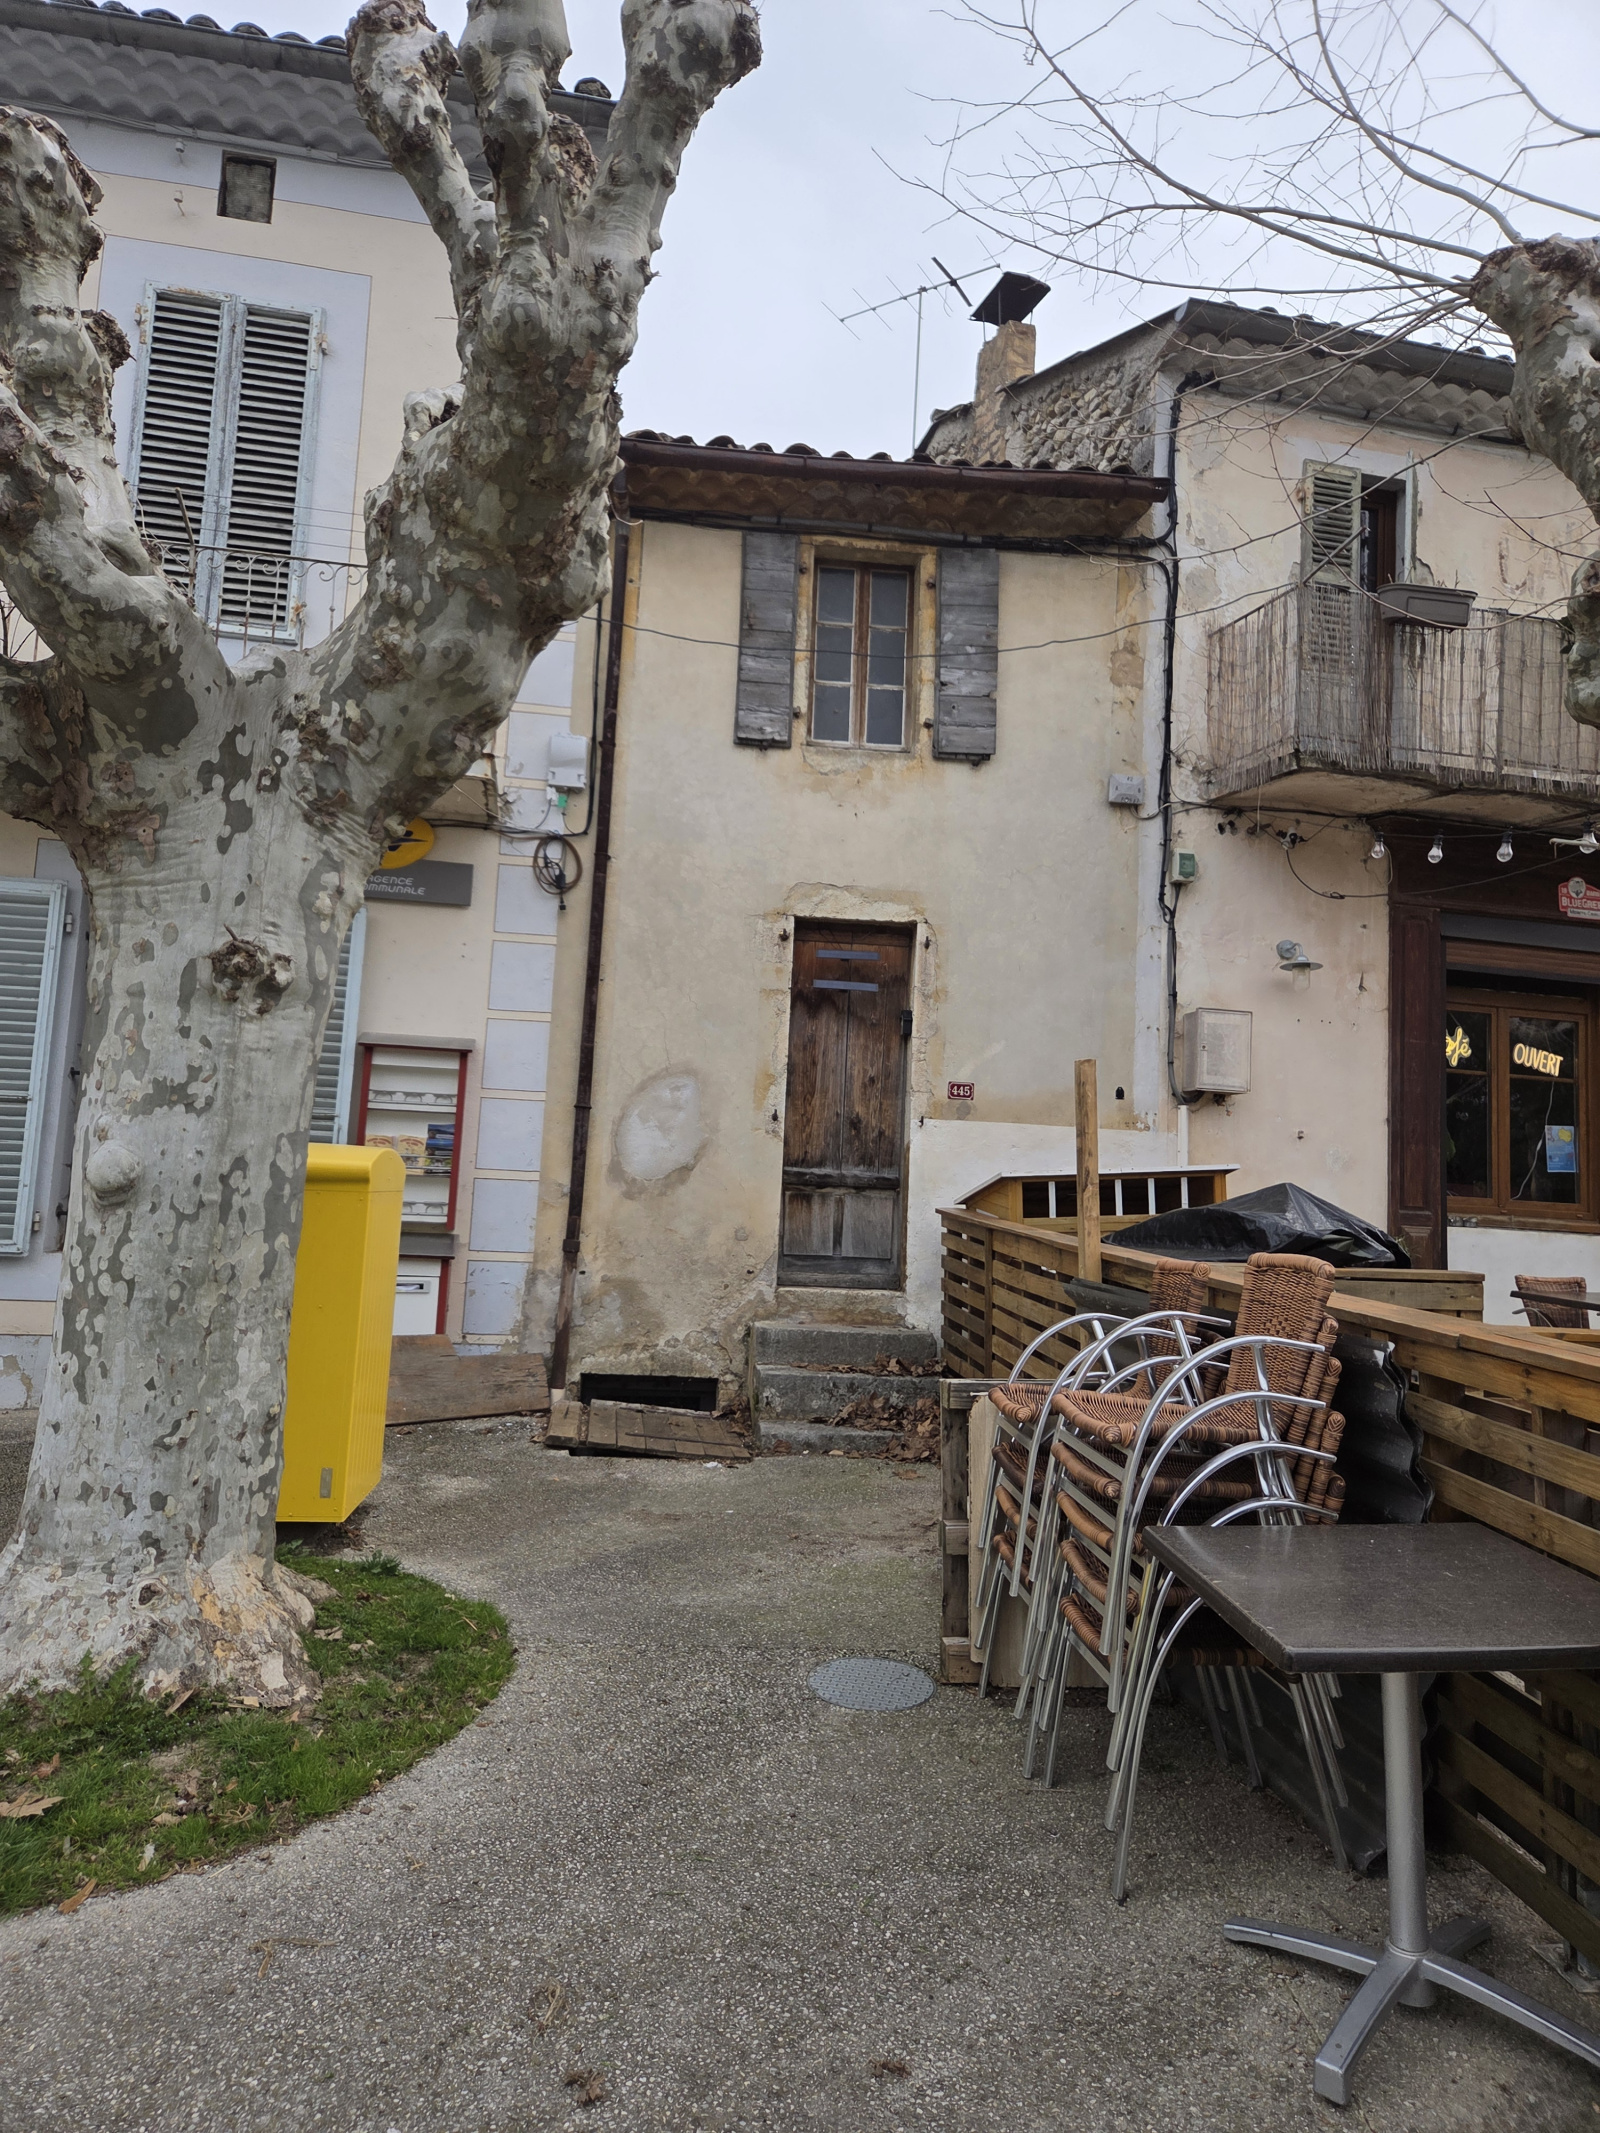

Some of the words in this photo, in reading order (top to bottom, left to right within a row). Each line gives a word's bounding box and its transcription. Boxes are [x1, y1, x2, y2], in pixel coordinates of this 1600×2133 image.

[369, 875, 414, 886] AGENCE
[364, 883, 426, 896] OMMUNALE
[1513, 1042, 1564, 1077] OUVERT
[951, 1085, 970, 1096] 445
